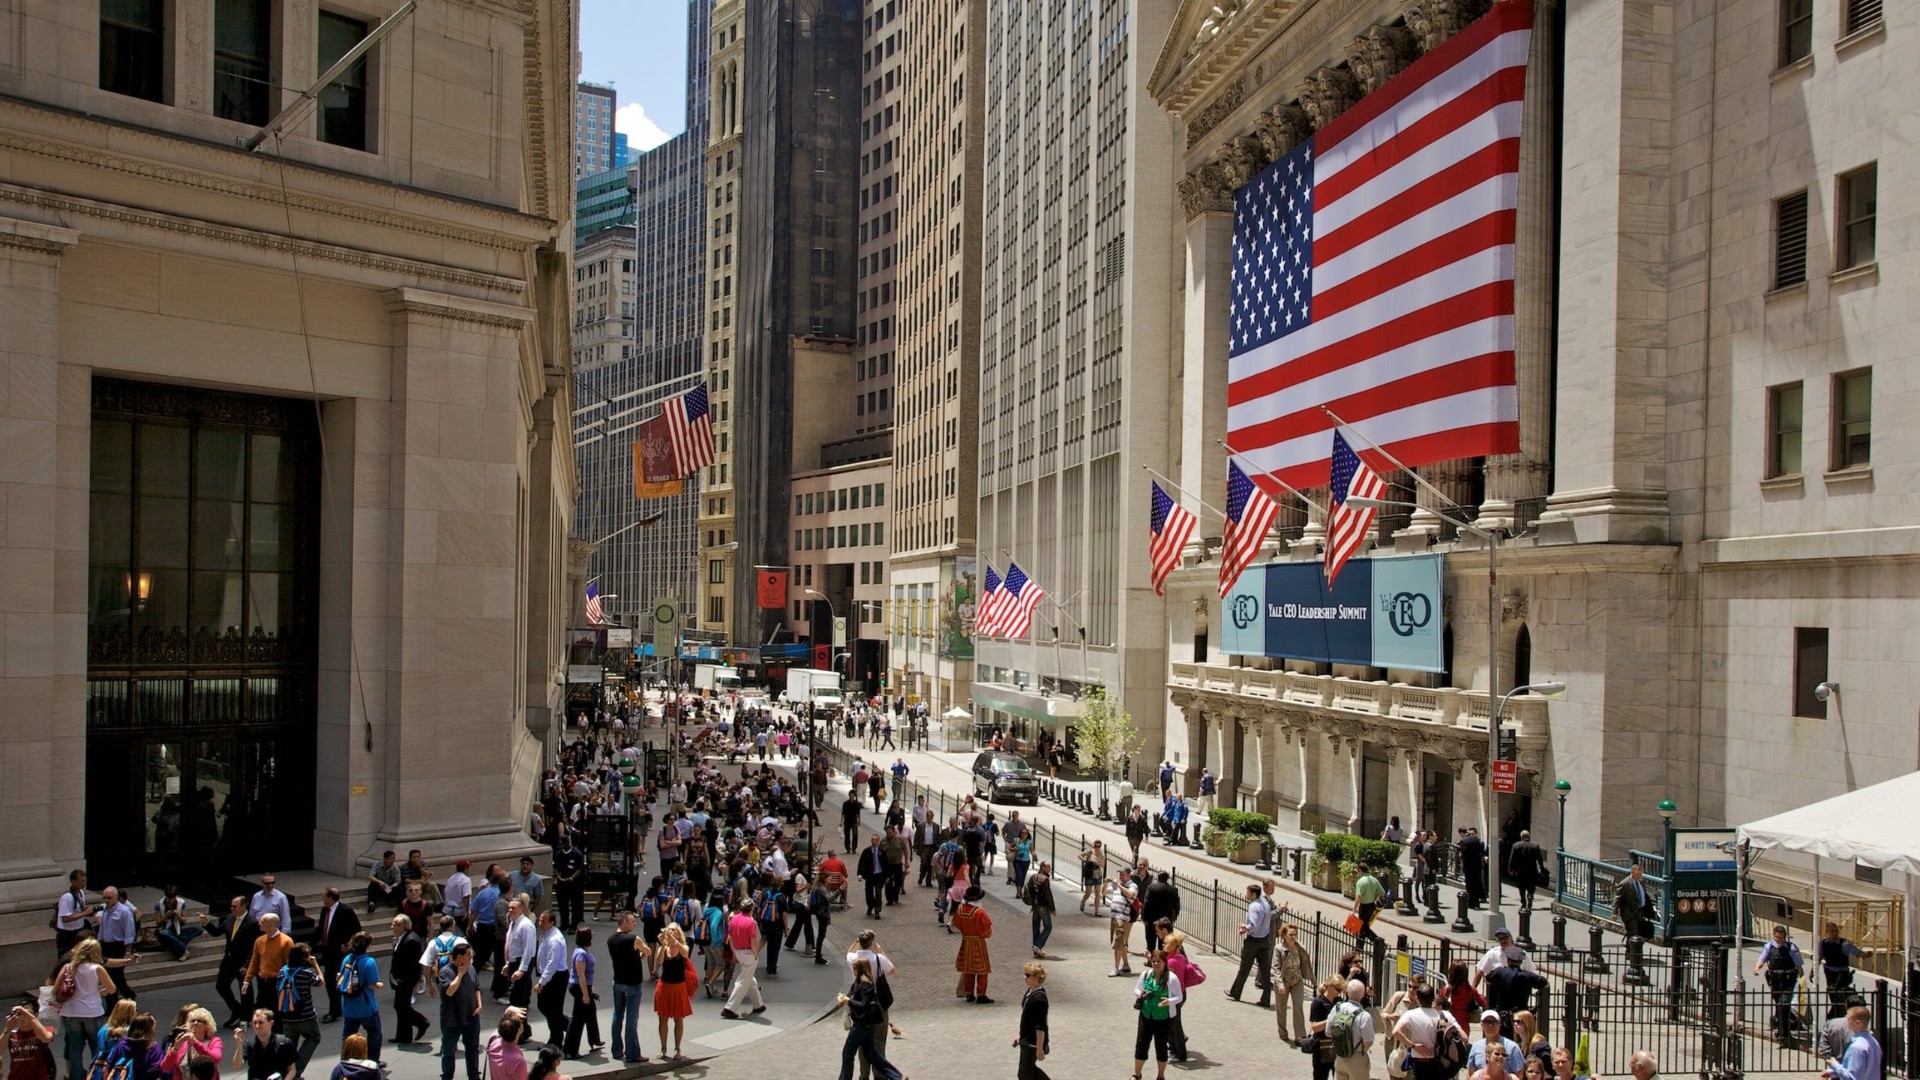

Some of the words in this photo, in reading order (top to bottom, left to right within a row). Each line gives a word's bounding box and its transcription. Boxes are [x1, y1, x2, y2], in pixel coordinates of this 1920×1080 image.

[1268, 603, 1283, 618] YALE
[1283, 603, 1297, 618] CEO
[1298, 603, 1337, 619] LEADERSHIP
[1339, 604, 1367, 619] SUMMIT
[1684, 841, 1705, 850] ALWAYS
[1592, 868, 1615, 884] Subway
[1677, 890, 1699, 898] Broad
[1700, 890, 1709, 898] St
